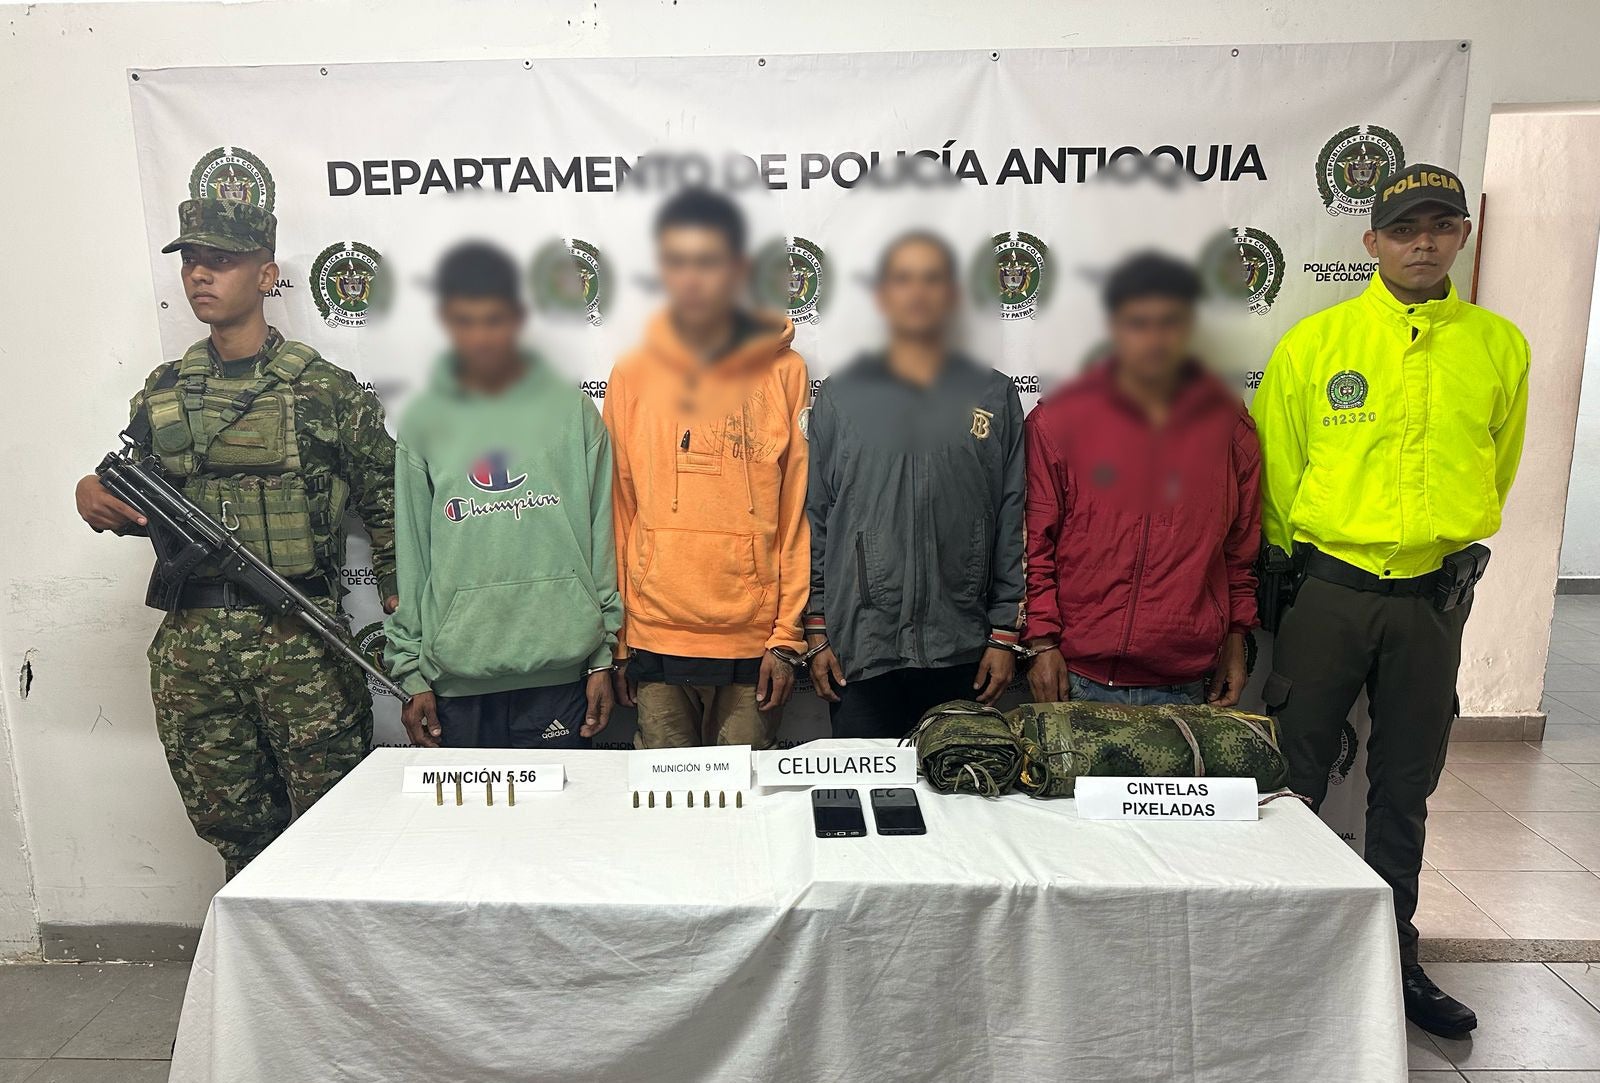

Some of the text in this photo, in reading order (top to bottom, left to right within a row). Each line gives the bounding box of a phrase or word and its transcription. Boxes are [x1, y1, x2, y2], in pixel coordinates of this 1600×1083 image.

[723, 153, 788, 190] DE
[1303, 260, 1380, 273] POLICÍA NACIO
[1315, 272, 1372, 282] DE COLOM
[1322, 411, 1377, 427] 612320
[444, 490, 561, 523] Champion
[341, 566, 375, 577] OLICÍA
[347, 577, 362, 585] DE
[541, 728, 570, 741] adidas
[652, 762, 730, 774] MUNICIÓN 9 MM
[777, 755, 898, 776] CELULARES
[506, 770, 537, 784] 5.56
[1126, 782, 1210, 797] CINTELAS
[1122, 802, 1216, 817] PIXELADAS
